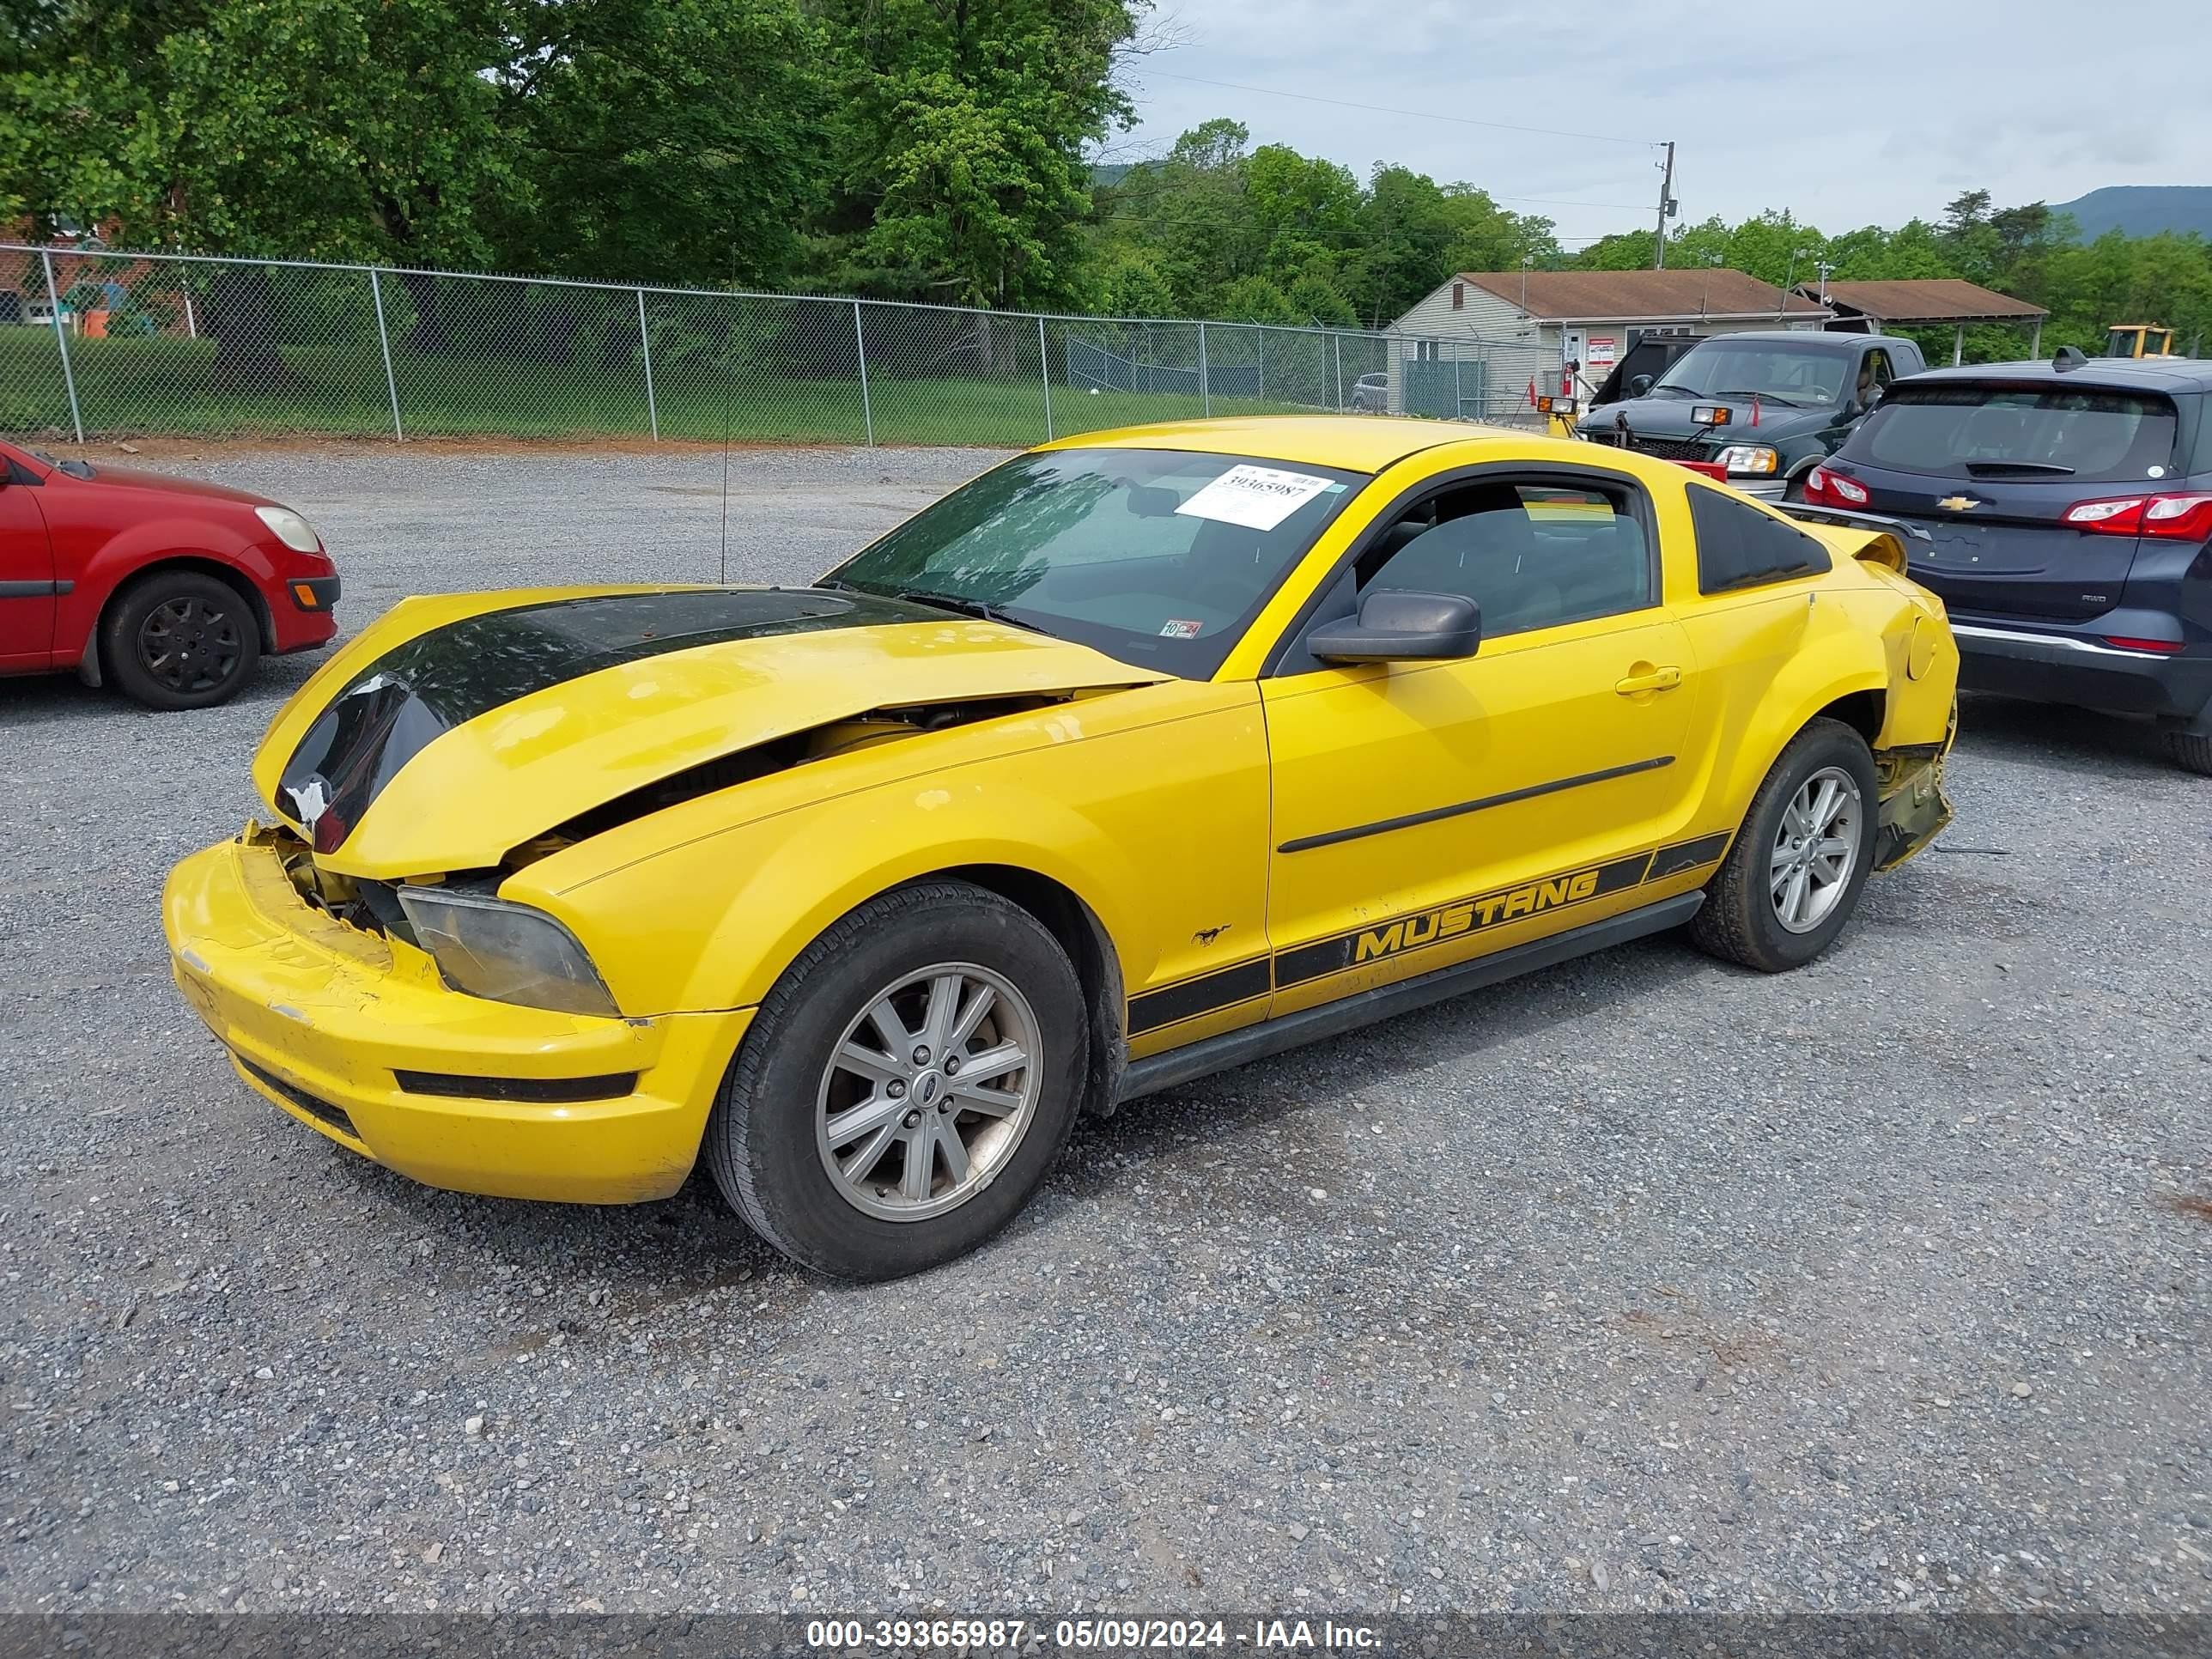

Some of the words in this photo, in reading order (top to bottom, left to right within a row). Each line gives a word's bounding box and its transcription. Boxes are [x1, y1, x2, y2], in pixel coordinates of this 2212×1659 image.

[1224, 476, 1308, 498] 39365987
[1164, 623, 1178, 634] 10
[1355, 870, 1599, 961] MUSTANG
